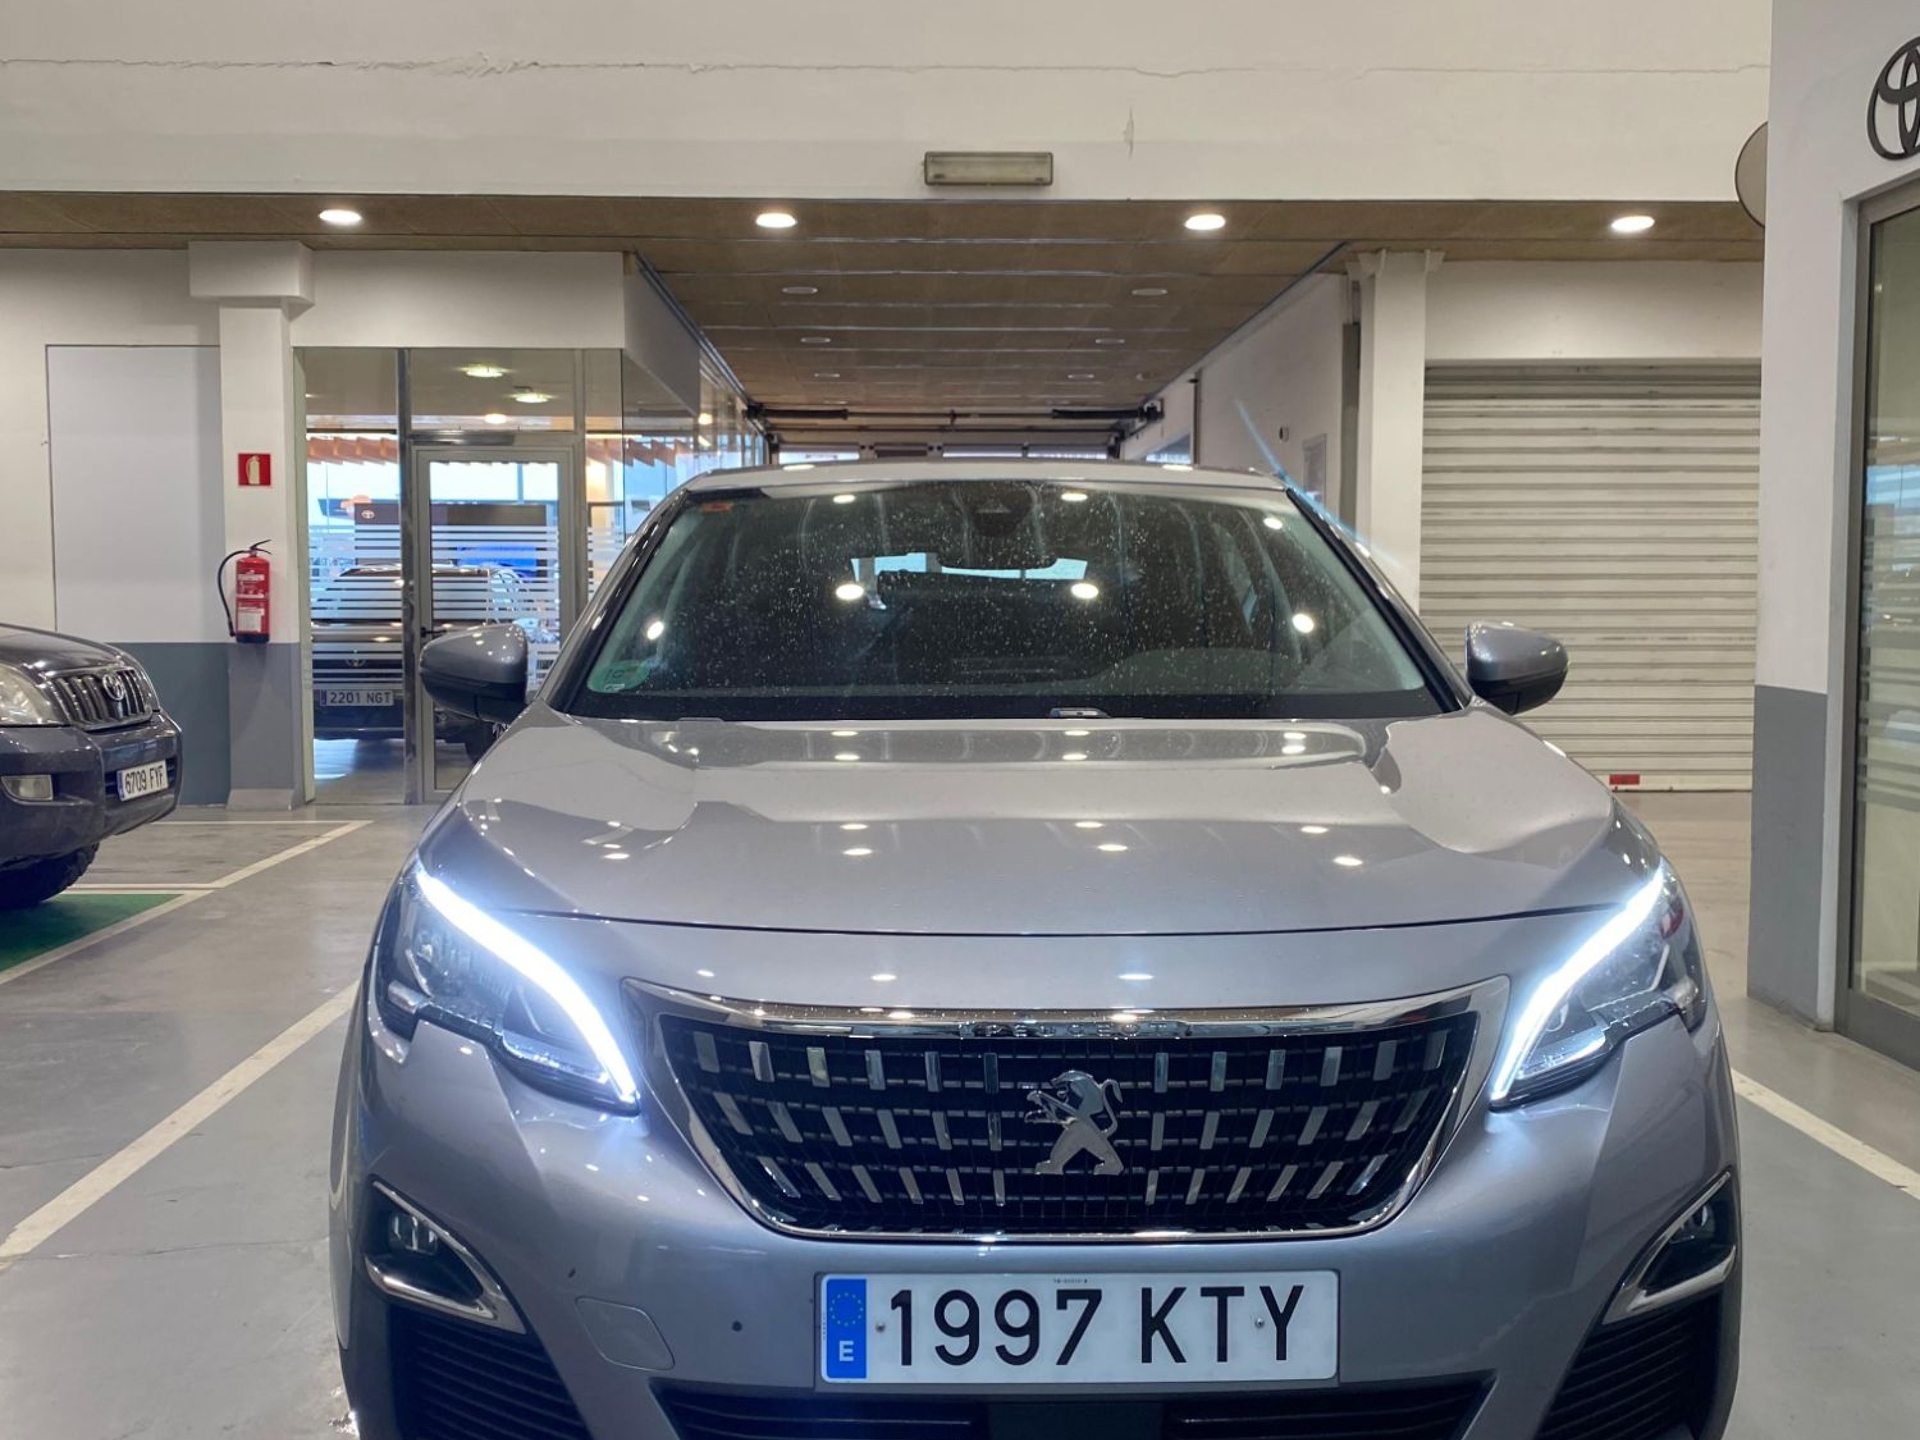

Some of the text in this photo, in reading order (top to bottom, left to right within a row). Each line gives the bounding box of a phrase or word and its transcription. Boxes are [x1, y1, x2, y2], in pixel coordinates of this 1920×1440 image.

[329, 691, 391, 704] 2201 NGT
[125, 765, 163, 794] 6709 FYF
[985, 1023, 1168, 1038] PEUGEOT
[890, 1285, 1305, 1367] 1997 KTY
[838, 1340, 855, 1362] E
